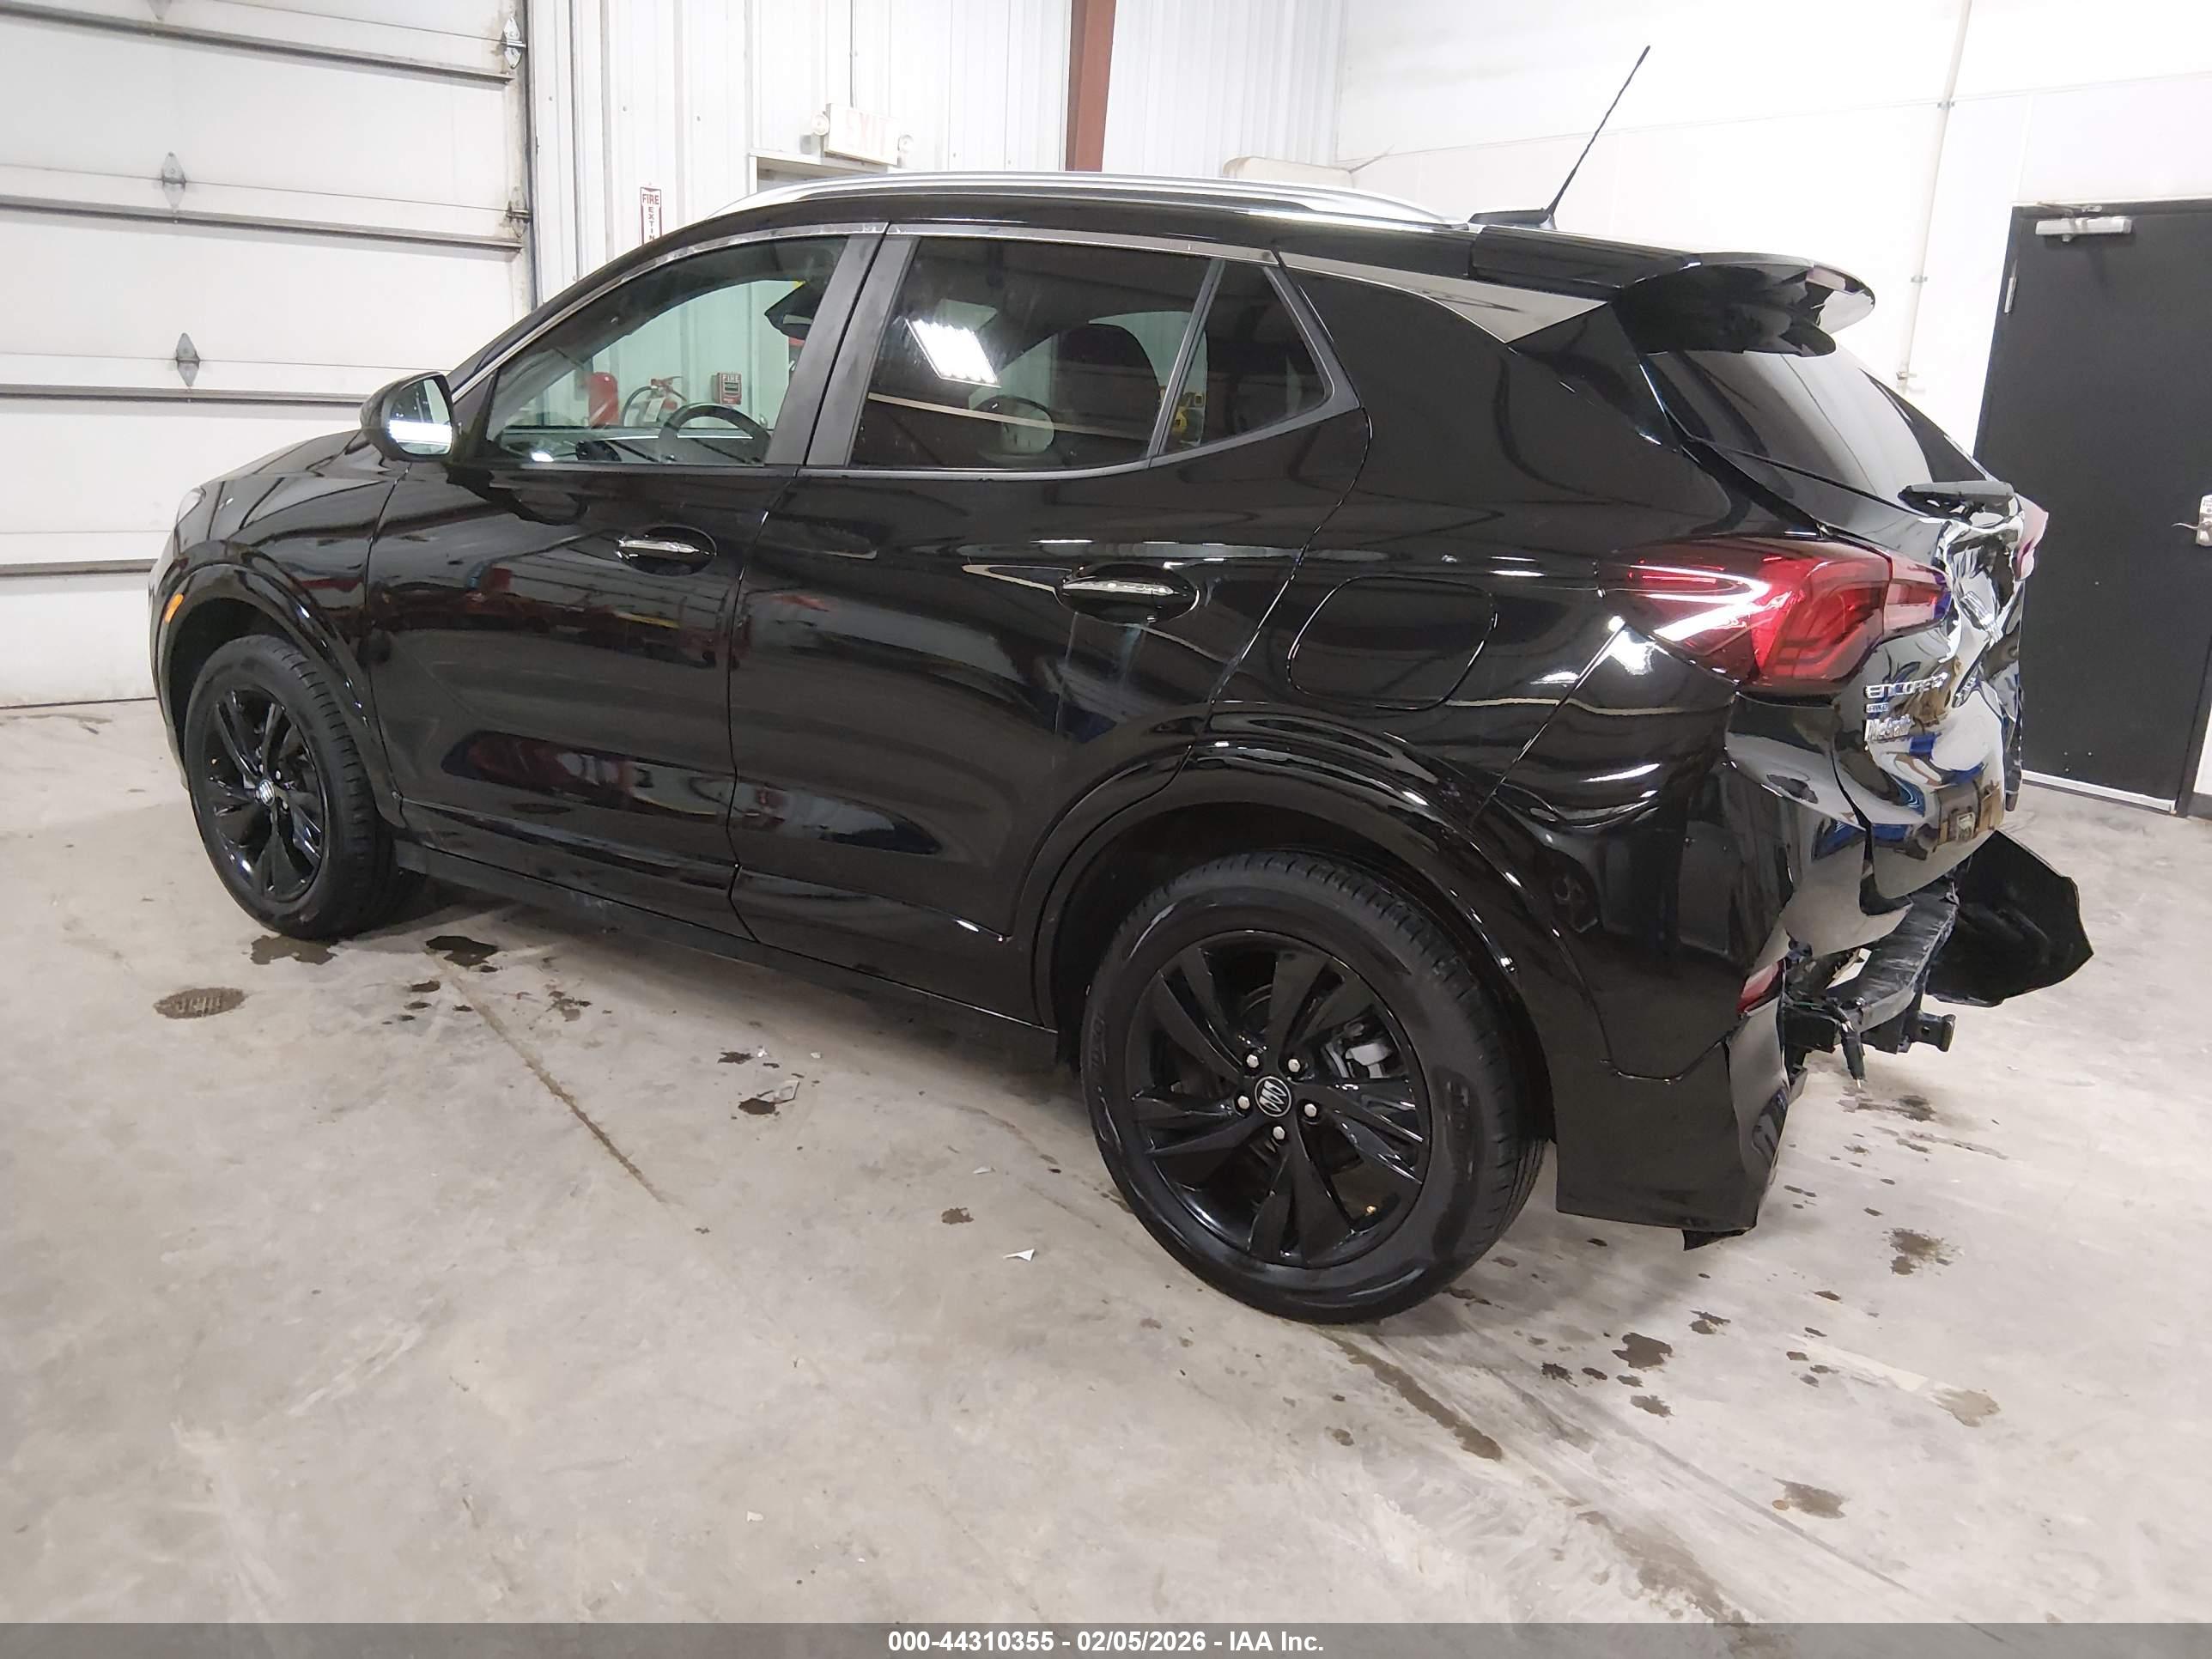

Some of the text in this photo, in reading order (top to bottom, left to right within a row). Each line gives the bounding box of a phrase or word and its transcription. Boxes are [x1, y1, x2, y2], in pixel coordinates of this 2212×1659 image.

[845, 110, 893, 155] EXIT
[642, 193, 659, 205] FIRE
[722, 373, 741, 382] FIRE
